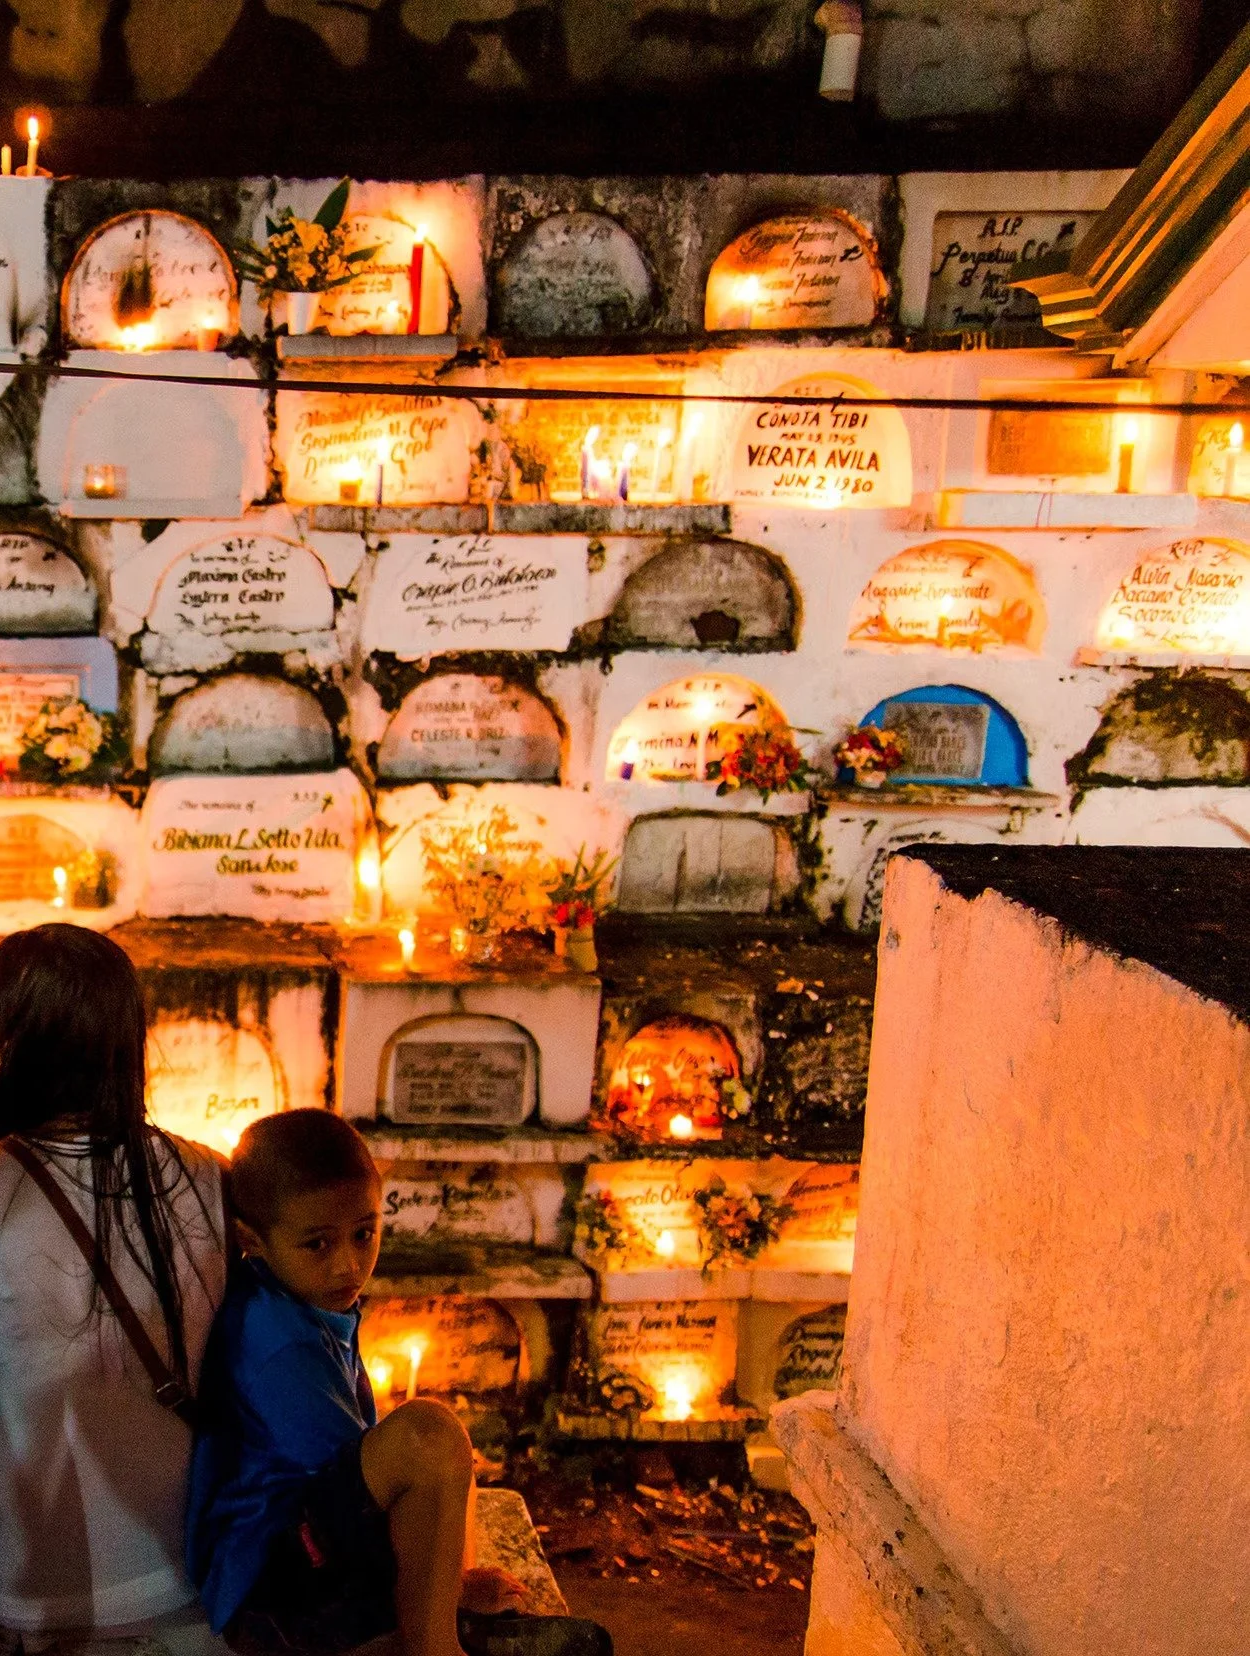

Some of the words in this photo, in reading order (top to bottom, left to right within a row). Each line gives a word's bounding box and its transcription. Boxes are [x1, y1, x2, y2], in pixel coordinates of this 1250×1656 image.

[831, 411, 869, 429] TIBI
[747, 443, 817, 468] VERATA
[824, 449, 881, 473] AVILA
[773, 473, 810, 488] JUN
[814, 475, 827, 490] 2
[834, 476, 874, 495] 1980
